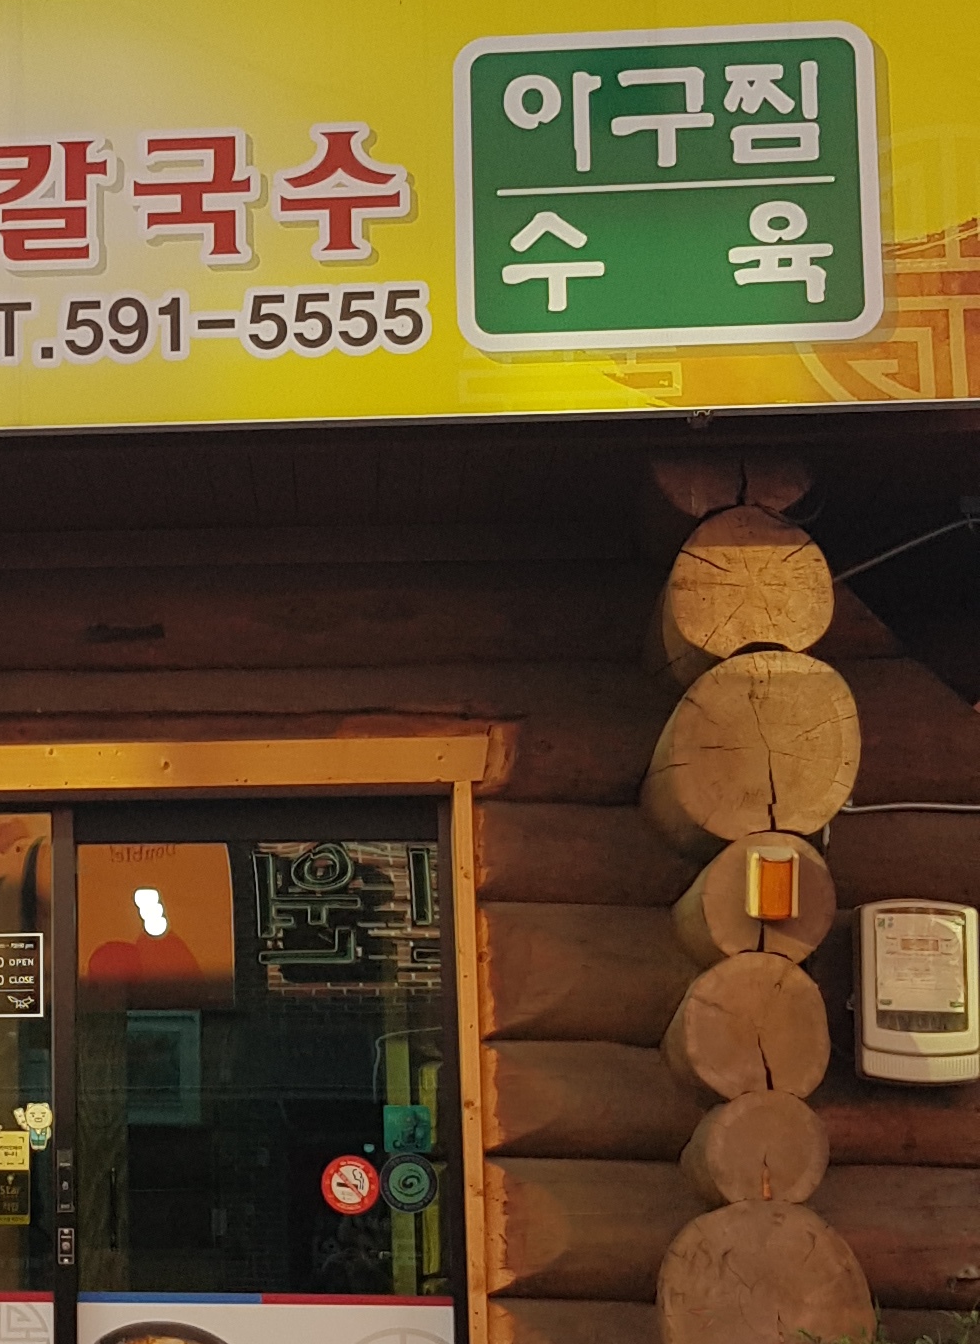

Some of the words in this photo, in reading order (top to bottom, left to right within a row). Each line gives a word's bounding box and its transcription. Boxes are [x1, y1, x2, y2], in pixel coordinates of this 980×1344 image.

[503, 60, 820, 172] 아구찜
[8, 958, 34, 967] OPEN
[8, 976, 35, 984] CLOSE
